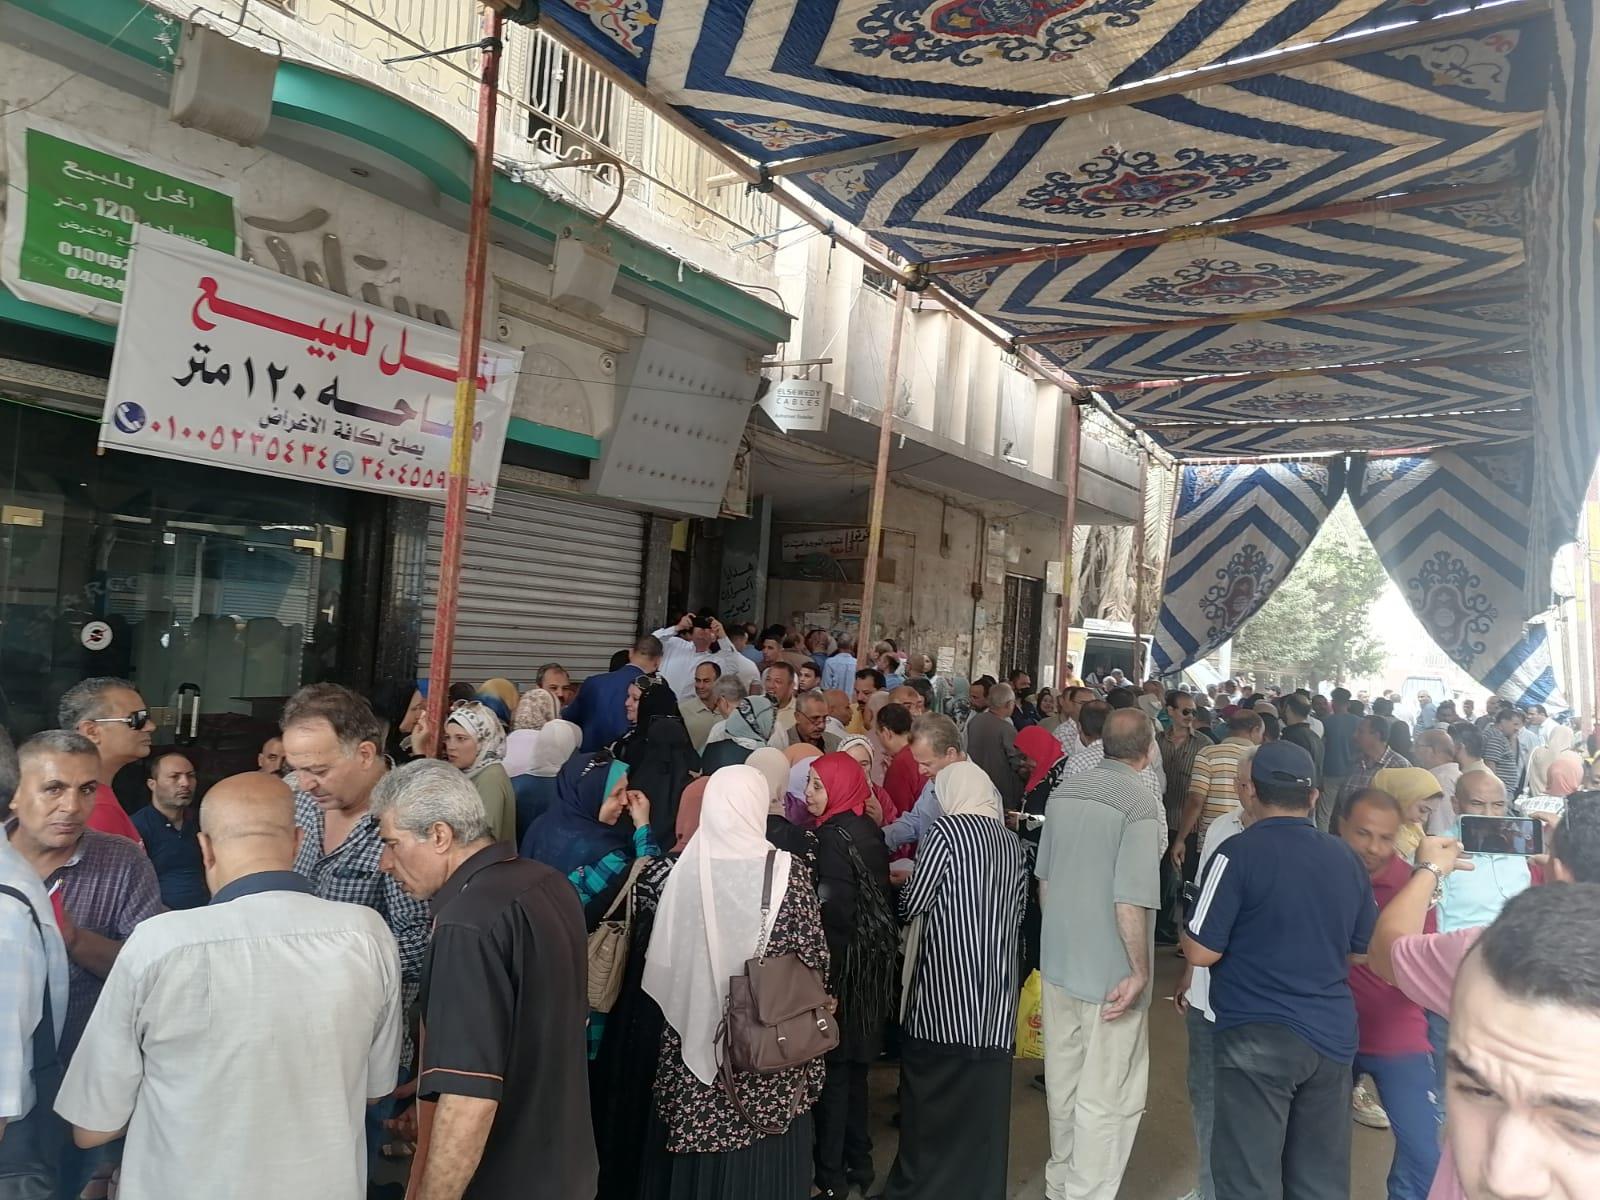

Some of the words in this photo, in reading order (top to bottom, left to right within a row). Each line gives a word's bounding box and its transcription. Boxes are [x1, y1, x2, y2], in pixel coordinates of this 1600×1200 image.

[62, 160, 136, 190] للبيع
[53, 196, 88, 212] متر
[93, 197, 136, 225] 120
[192, 276, 375, 362] للبيع
[172, 342, 231, 387] متر
[244, 356, 307, 403] ١٢٠
[776, 397, 821, 407] CABLES
[333, 419, 385, 447] لكافة
[388, 435, 426, 461] يصلح
